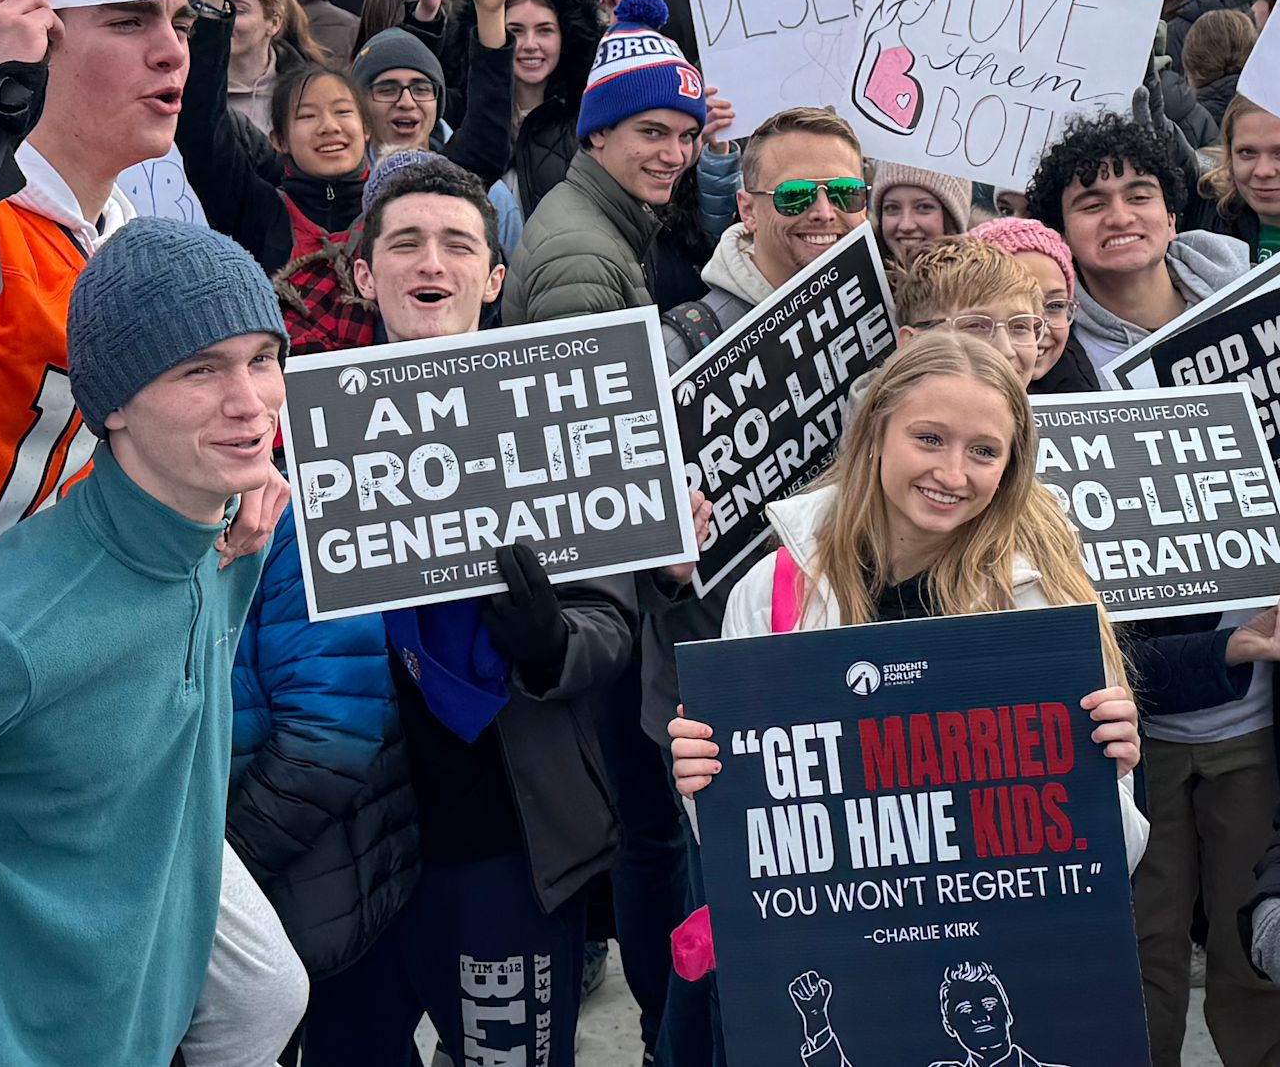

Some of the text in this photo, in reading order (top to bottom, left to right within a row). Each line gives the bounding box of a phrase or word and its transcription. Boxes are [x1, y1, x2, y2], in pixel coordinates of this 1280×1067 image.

[920, 43, 1125, 103] them
[694, 265, 840, 390] STUDENTSFORLIFE.ORG
[369, 337, 600, 388] STUDENTSFORLIFE.ORG
[701, 274, 869, 437] AM THE
[1169, 331, 1250, 388] GOD
[309, 360, 634, 449] I AM THE
[298, 408, 667, 521] PRO-LIFE
[1035, 424, 1242, 474] AM THE
[317, 477, 667, 575] GENERATION
[419, 565, 460, 587] TEXT
[463, 558, 500, 580] LIFE
[1128, 585, 1156, 602] LIFE
[1156, 584, 1177, 598] TO
[1177, 580, 1220, 597] 53445
[882, 660, 929, 673] STUDENTS
[884, 669, 922, 682] FOR LIFE
[730, 701, 1075, 800] “GET MARRIED
[745, 781, 1088, 880] AND HAVE KIDS.
[752, 886, 818, 920] YOU
[936, 866, 1049, 905] REGRET
[943, 920, 981, 940] KIRK
[468, 963, 494, 975] TIM
[496, 962, 523, 974] 4:12
